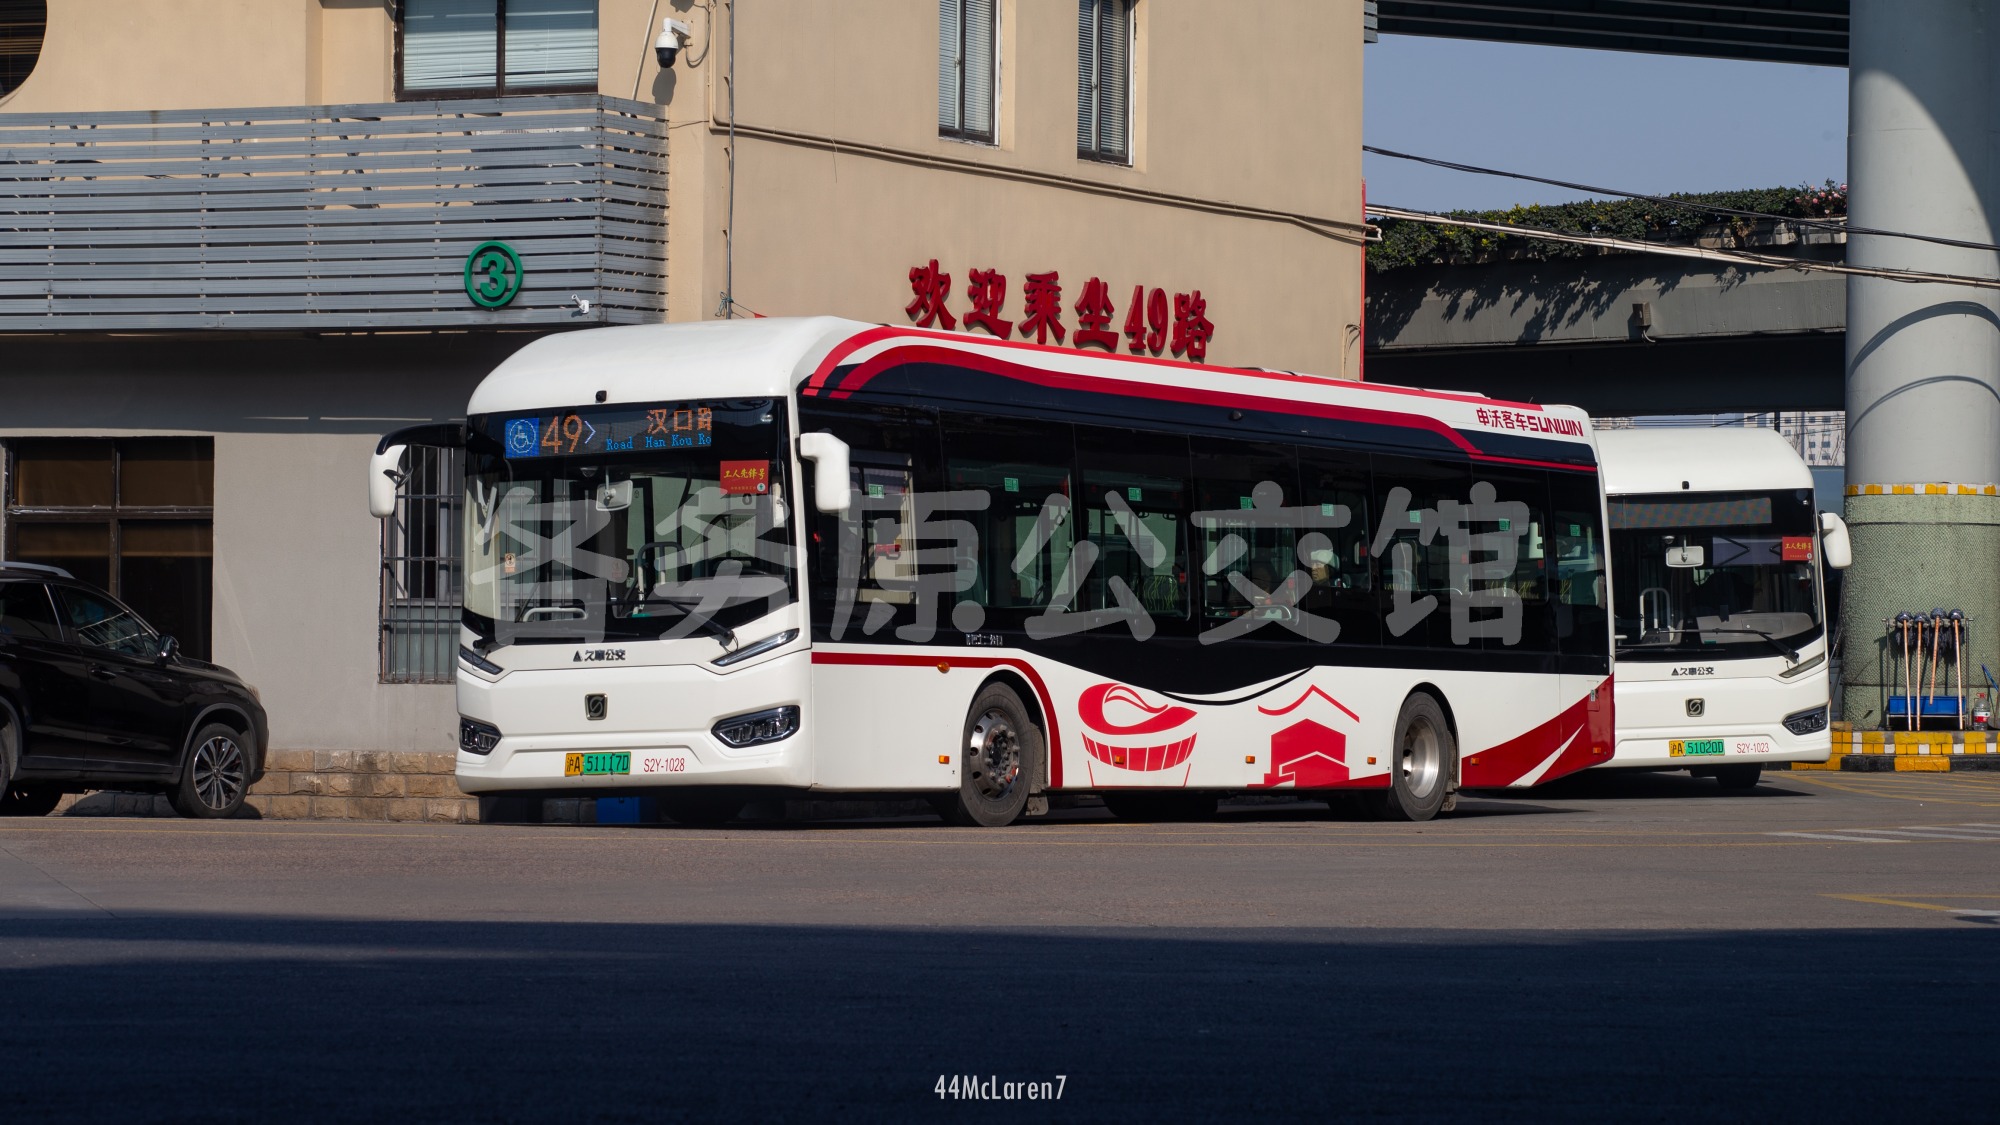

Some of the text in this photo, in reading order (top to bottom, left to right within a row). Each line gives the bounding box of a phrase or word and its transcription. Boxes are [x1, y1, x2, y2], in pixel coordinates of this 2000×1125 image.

[480, 252, 508, 298] 3
[905, 259, 1214, 359] 欢迎乘坐49路
[541, 415, 583, 454] 49
[606, 436, 634, 451] Road
[645, 435, 666, 448] Han
[671, 434, 693, 447] Kou
[723, 468, 765, 480] 工人先锋号
[1736, 743, 1769, 754] S2Y-1023
[643, 757, 685, 772] S2Y-1028
